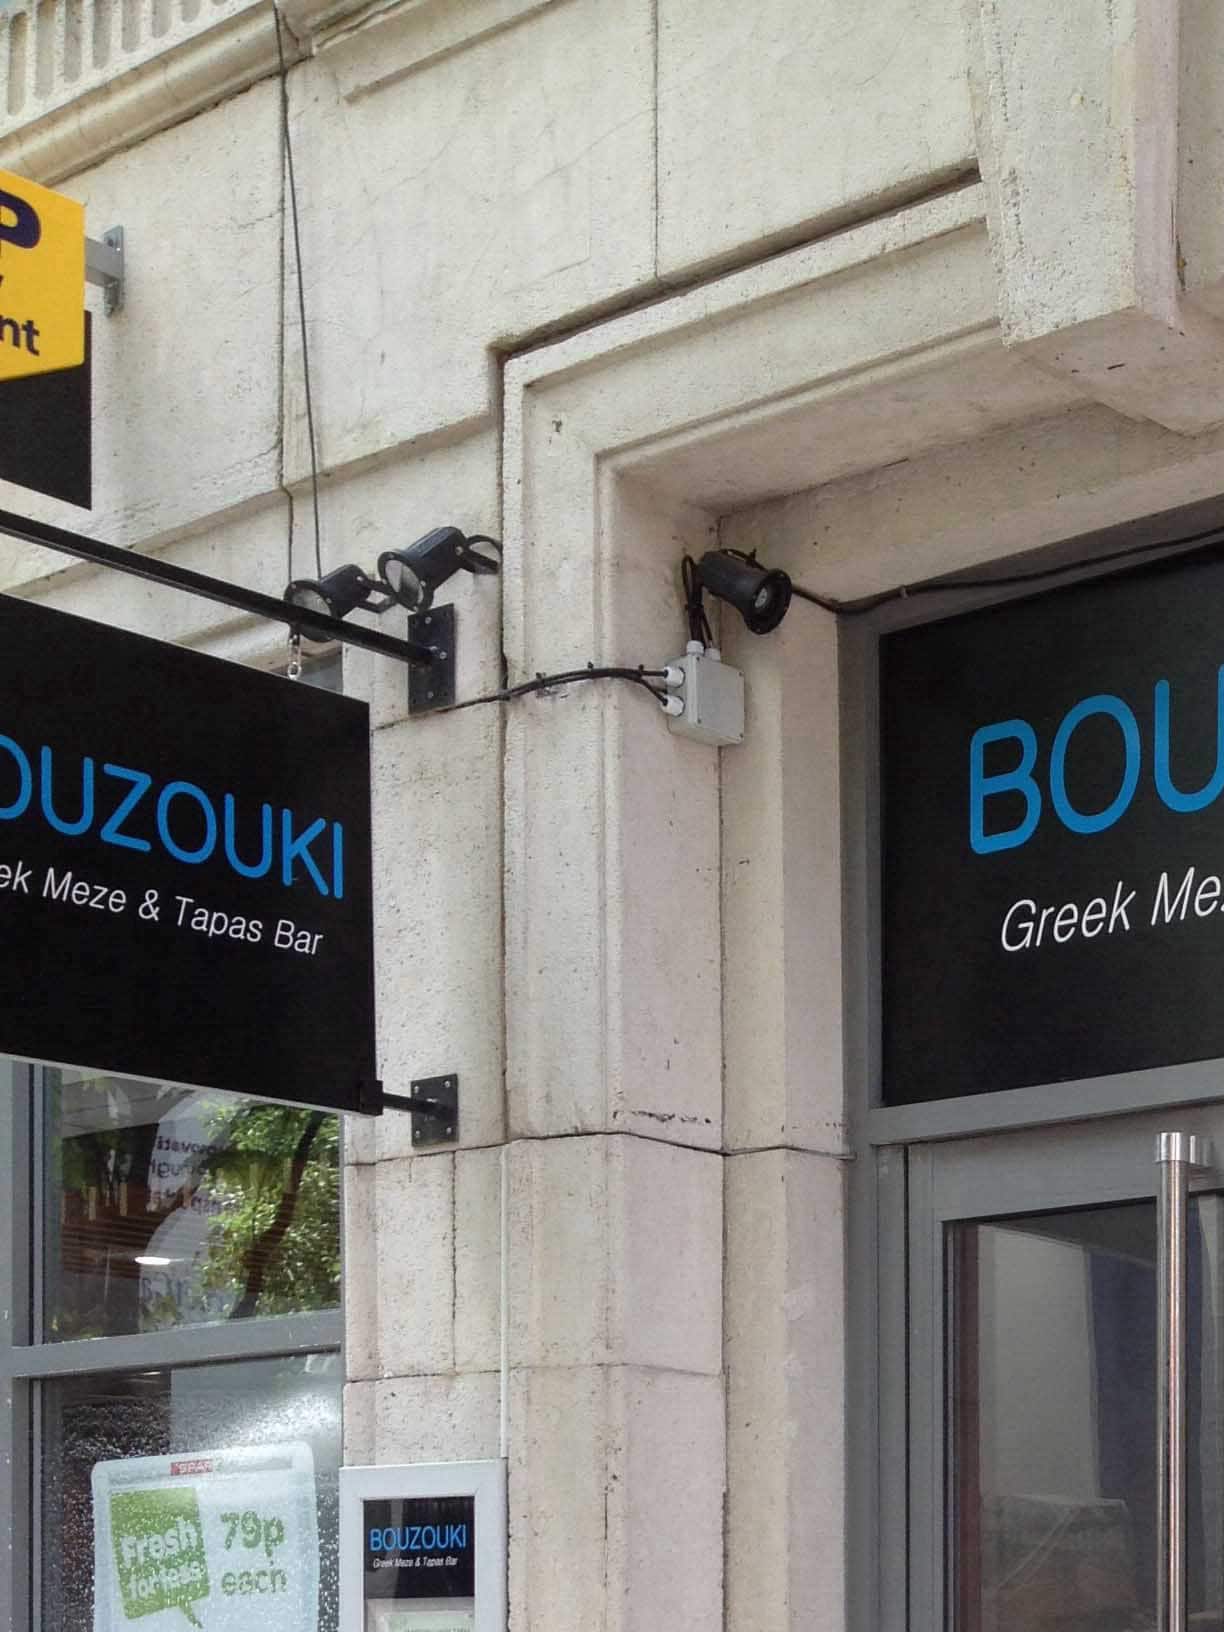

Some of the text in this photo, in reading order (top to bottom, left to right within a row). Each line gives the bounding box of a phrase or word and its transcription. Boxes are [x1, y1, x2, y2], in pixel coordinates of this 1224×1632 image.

[42, 866, 127, 914] Meze
[138, 889, 160, 921] &
[175, 896, 262, 943] Tapas
[274, 919, 324, 957] Bar
[1001, 880, 1131, 952] Greek
[120, 1515, 198, 1569] Fresh
[370, 1524, 466, 1551] BOUZOUKI
